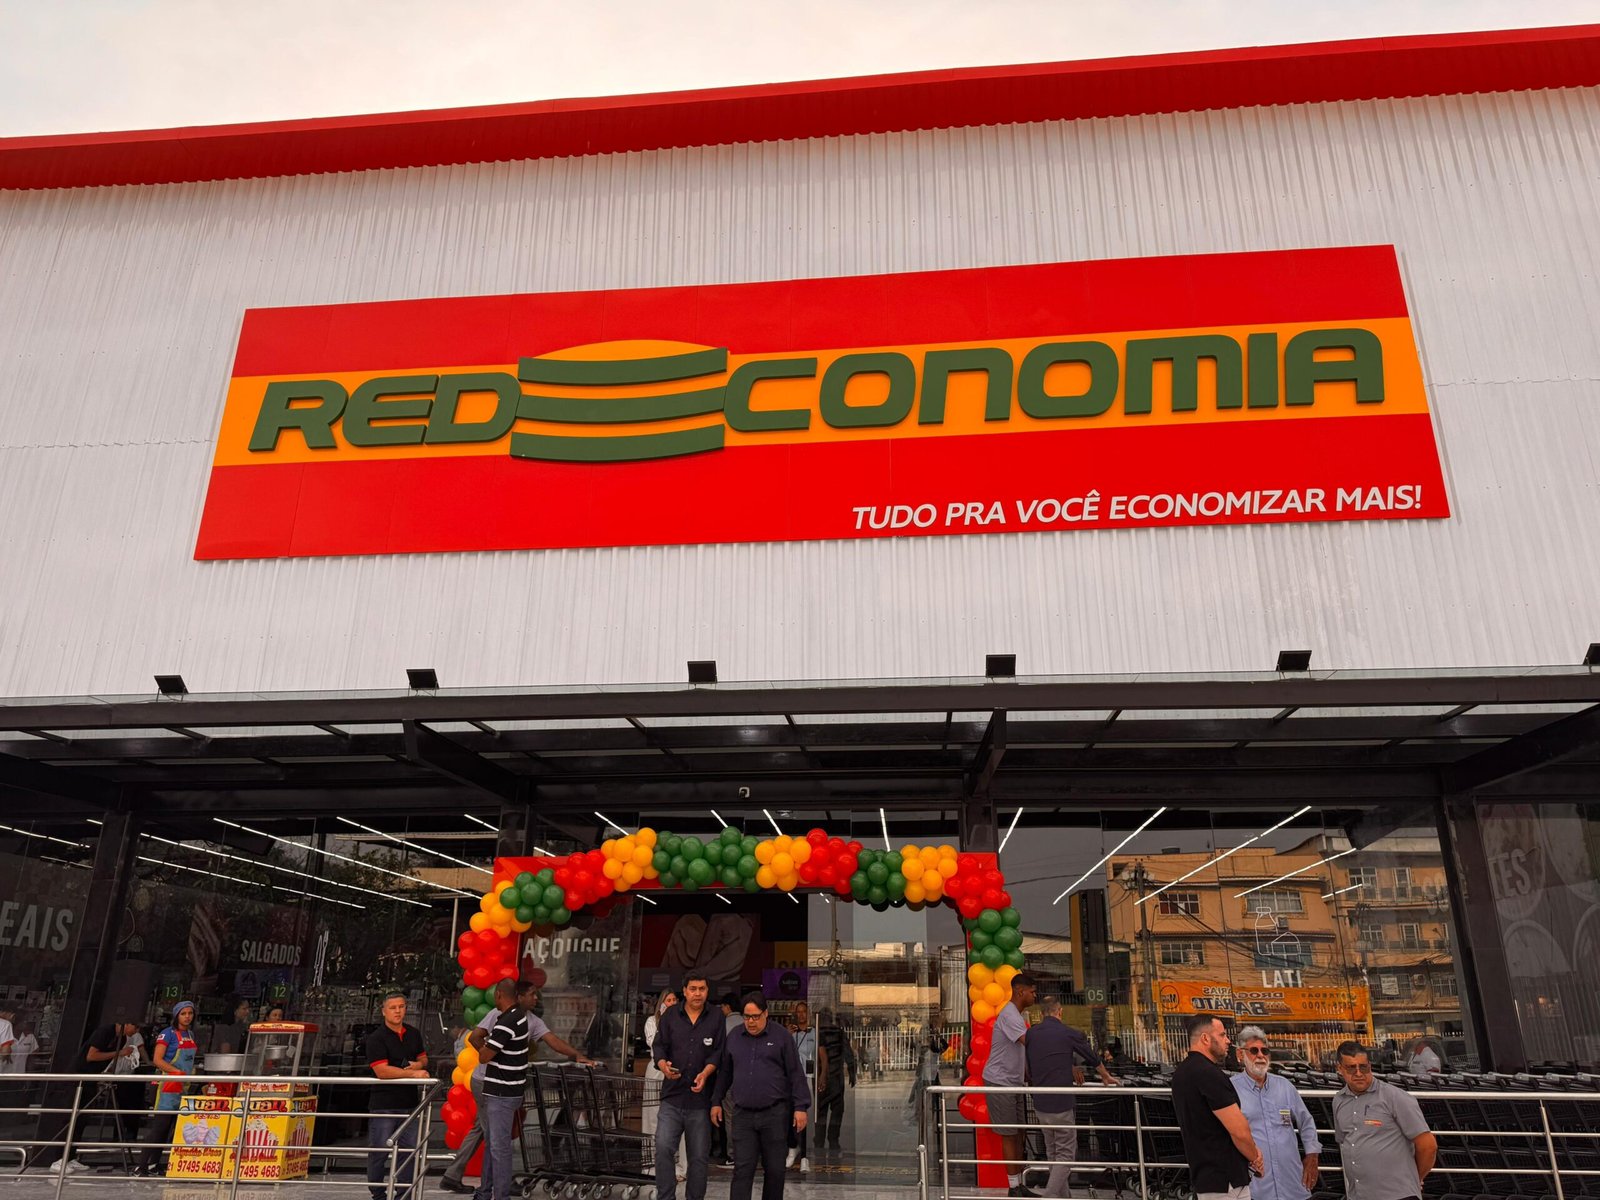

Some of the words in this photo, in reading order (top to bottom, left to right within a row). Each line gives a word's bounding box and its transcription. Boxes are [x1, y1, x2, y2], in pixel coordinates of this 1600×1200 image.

[852, 503, 937, 529] TUDO
[945, 502, 1006, 526] PRA
[1016, 489, 1100, 523] VOCÊ
[1109, 488, 1326, 520] ECONOMIZAR
[1336, 485, 1422, 511] MAIS!
[240, 939, 302, 966] SALGADOS
[165, 985, 179, 998] 13
[274, 985, 287, 998] 12
[1087, 989, 1104, 1001] 05
[177, 1160, 201, 1173] 97495
[202, 1161, 222, 1174] 4683
[238, 1165, 259, 1178] 7495
[261, 1165, 281, 1178] 4683
